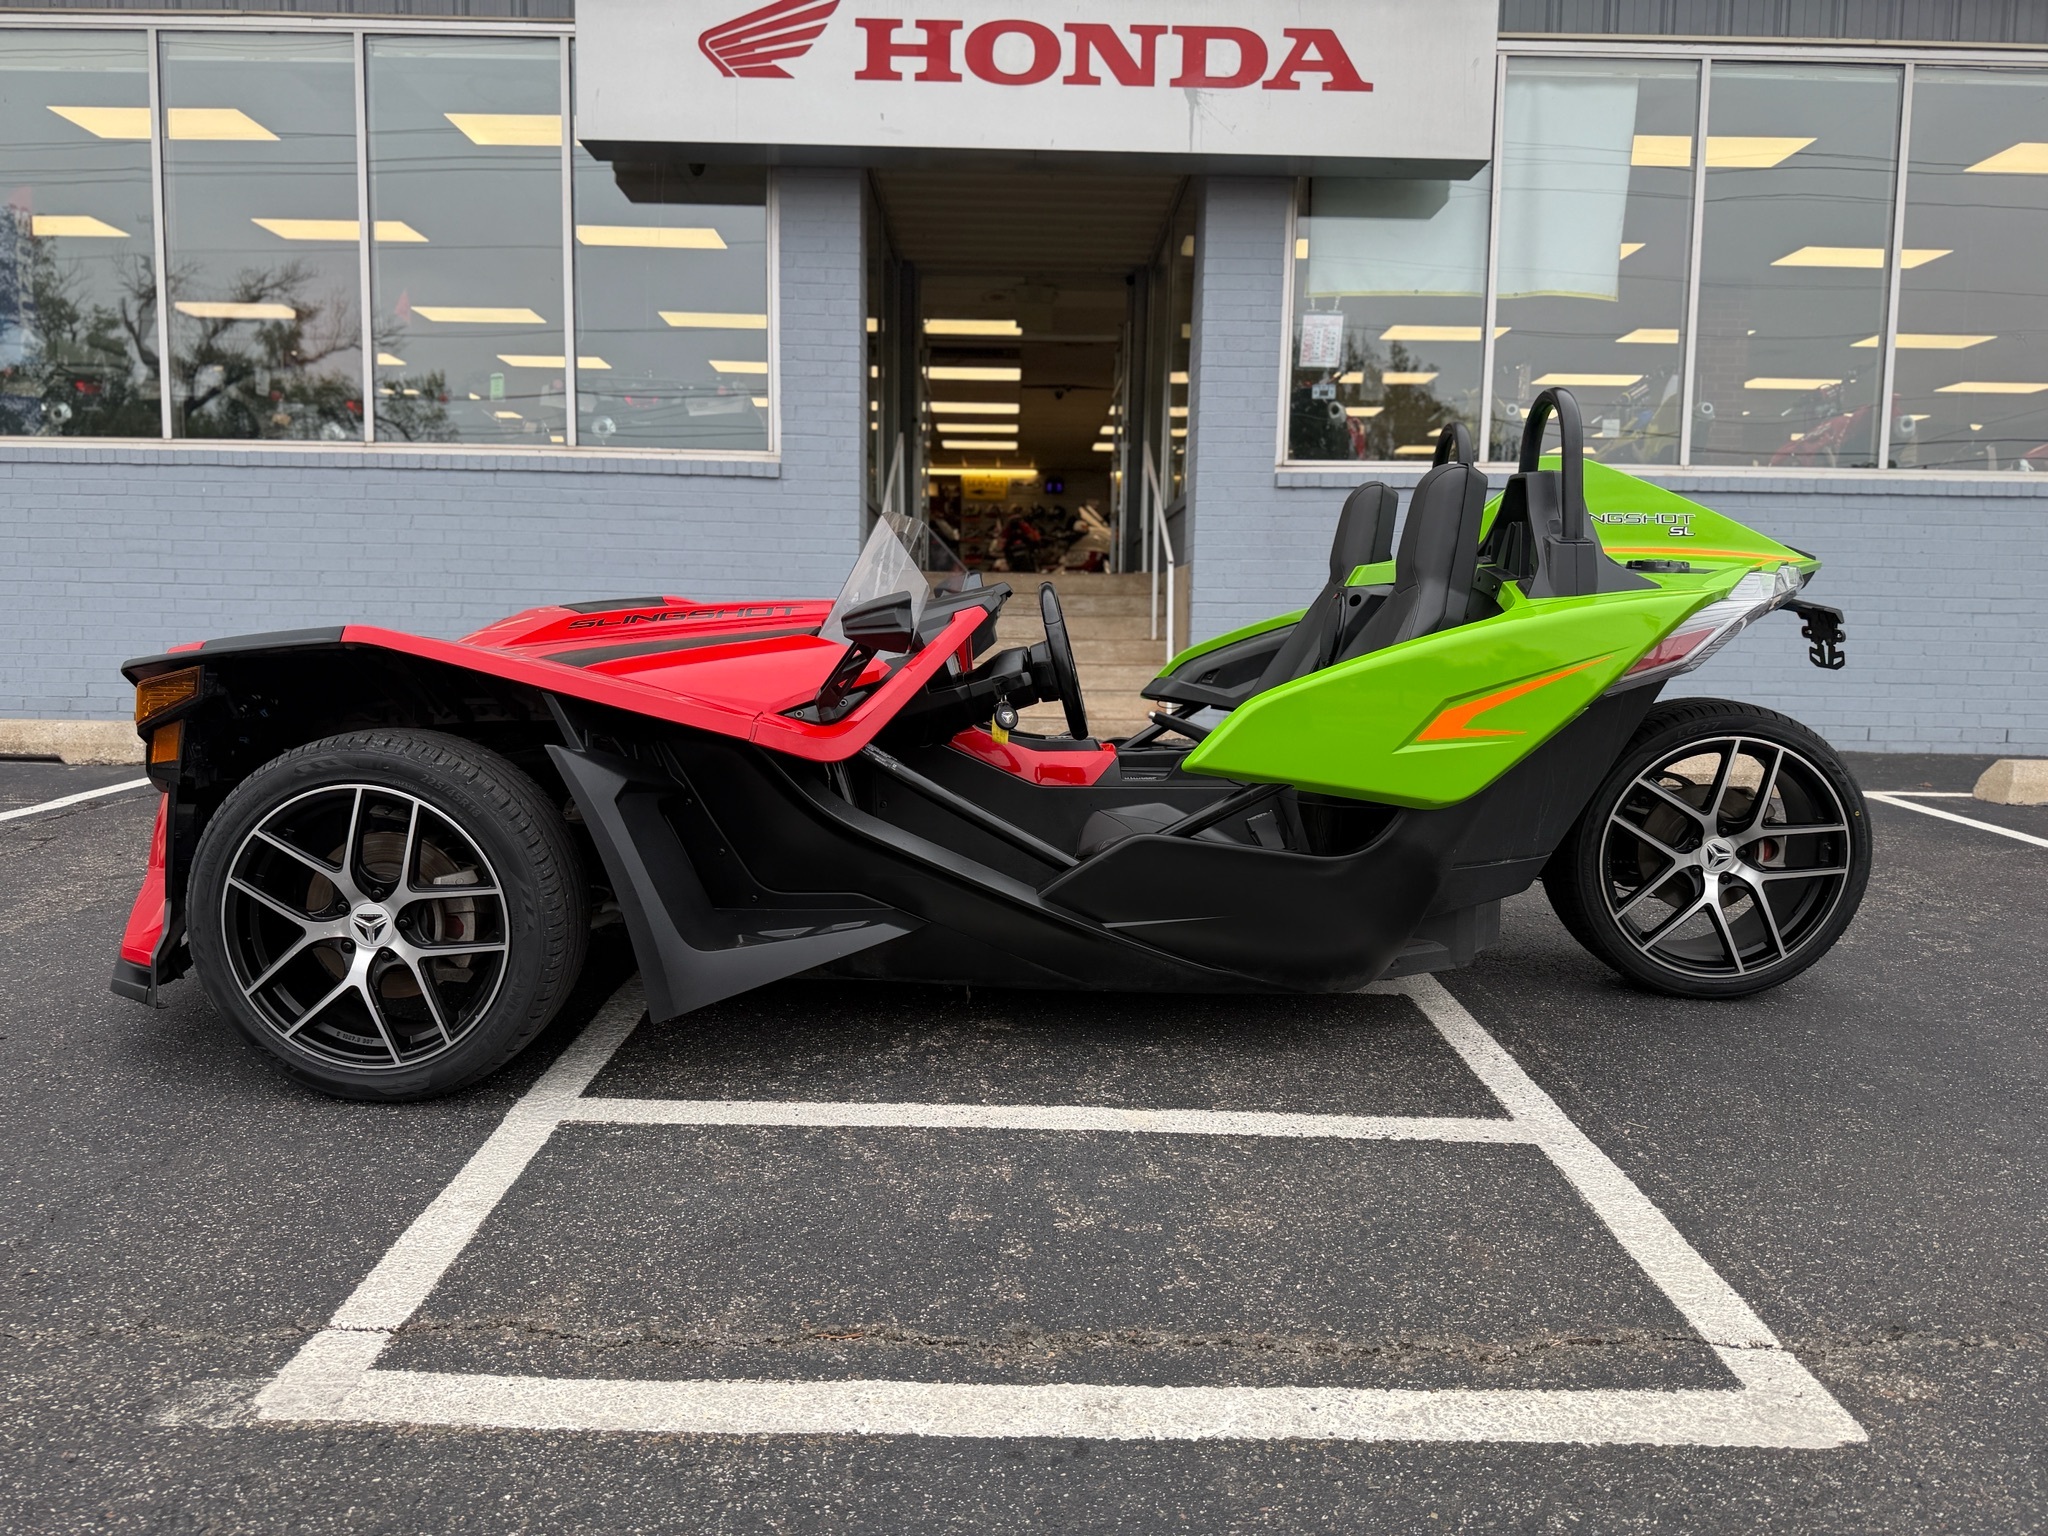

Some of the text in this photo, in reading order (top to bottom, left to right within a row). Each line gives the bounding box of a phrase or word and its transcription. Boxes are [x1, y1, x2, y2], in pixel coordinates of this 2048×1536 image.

[855, 18, 1374, 92] HONDA
[1588, 512, 1696, 525] NGSHOT
[1668, 526, 1696, 536] SL
[567, 606, 804, 630] SLINGSHOT
